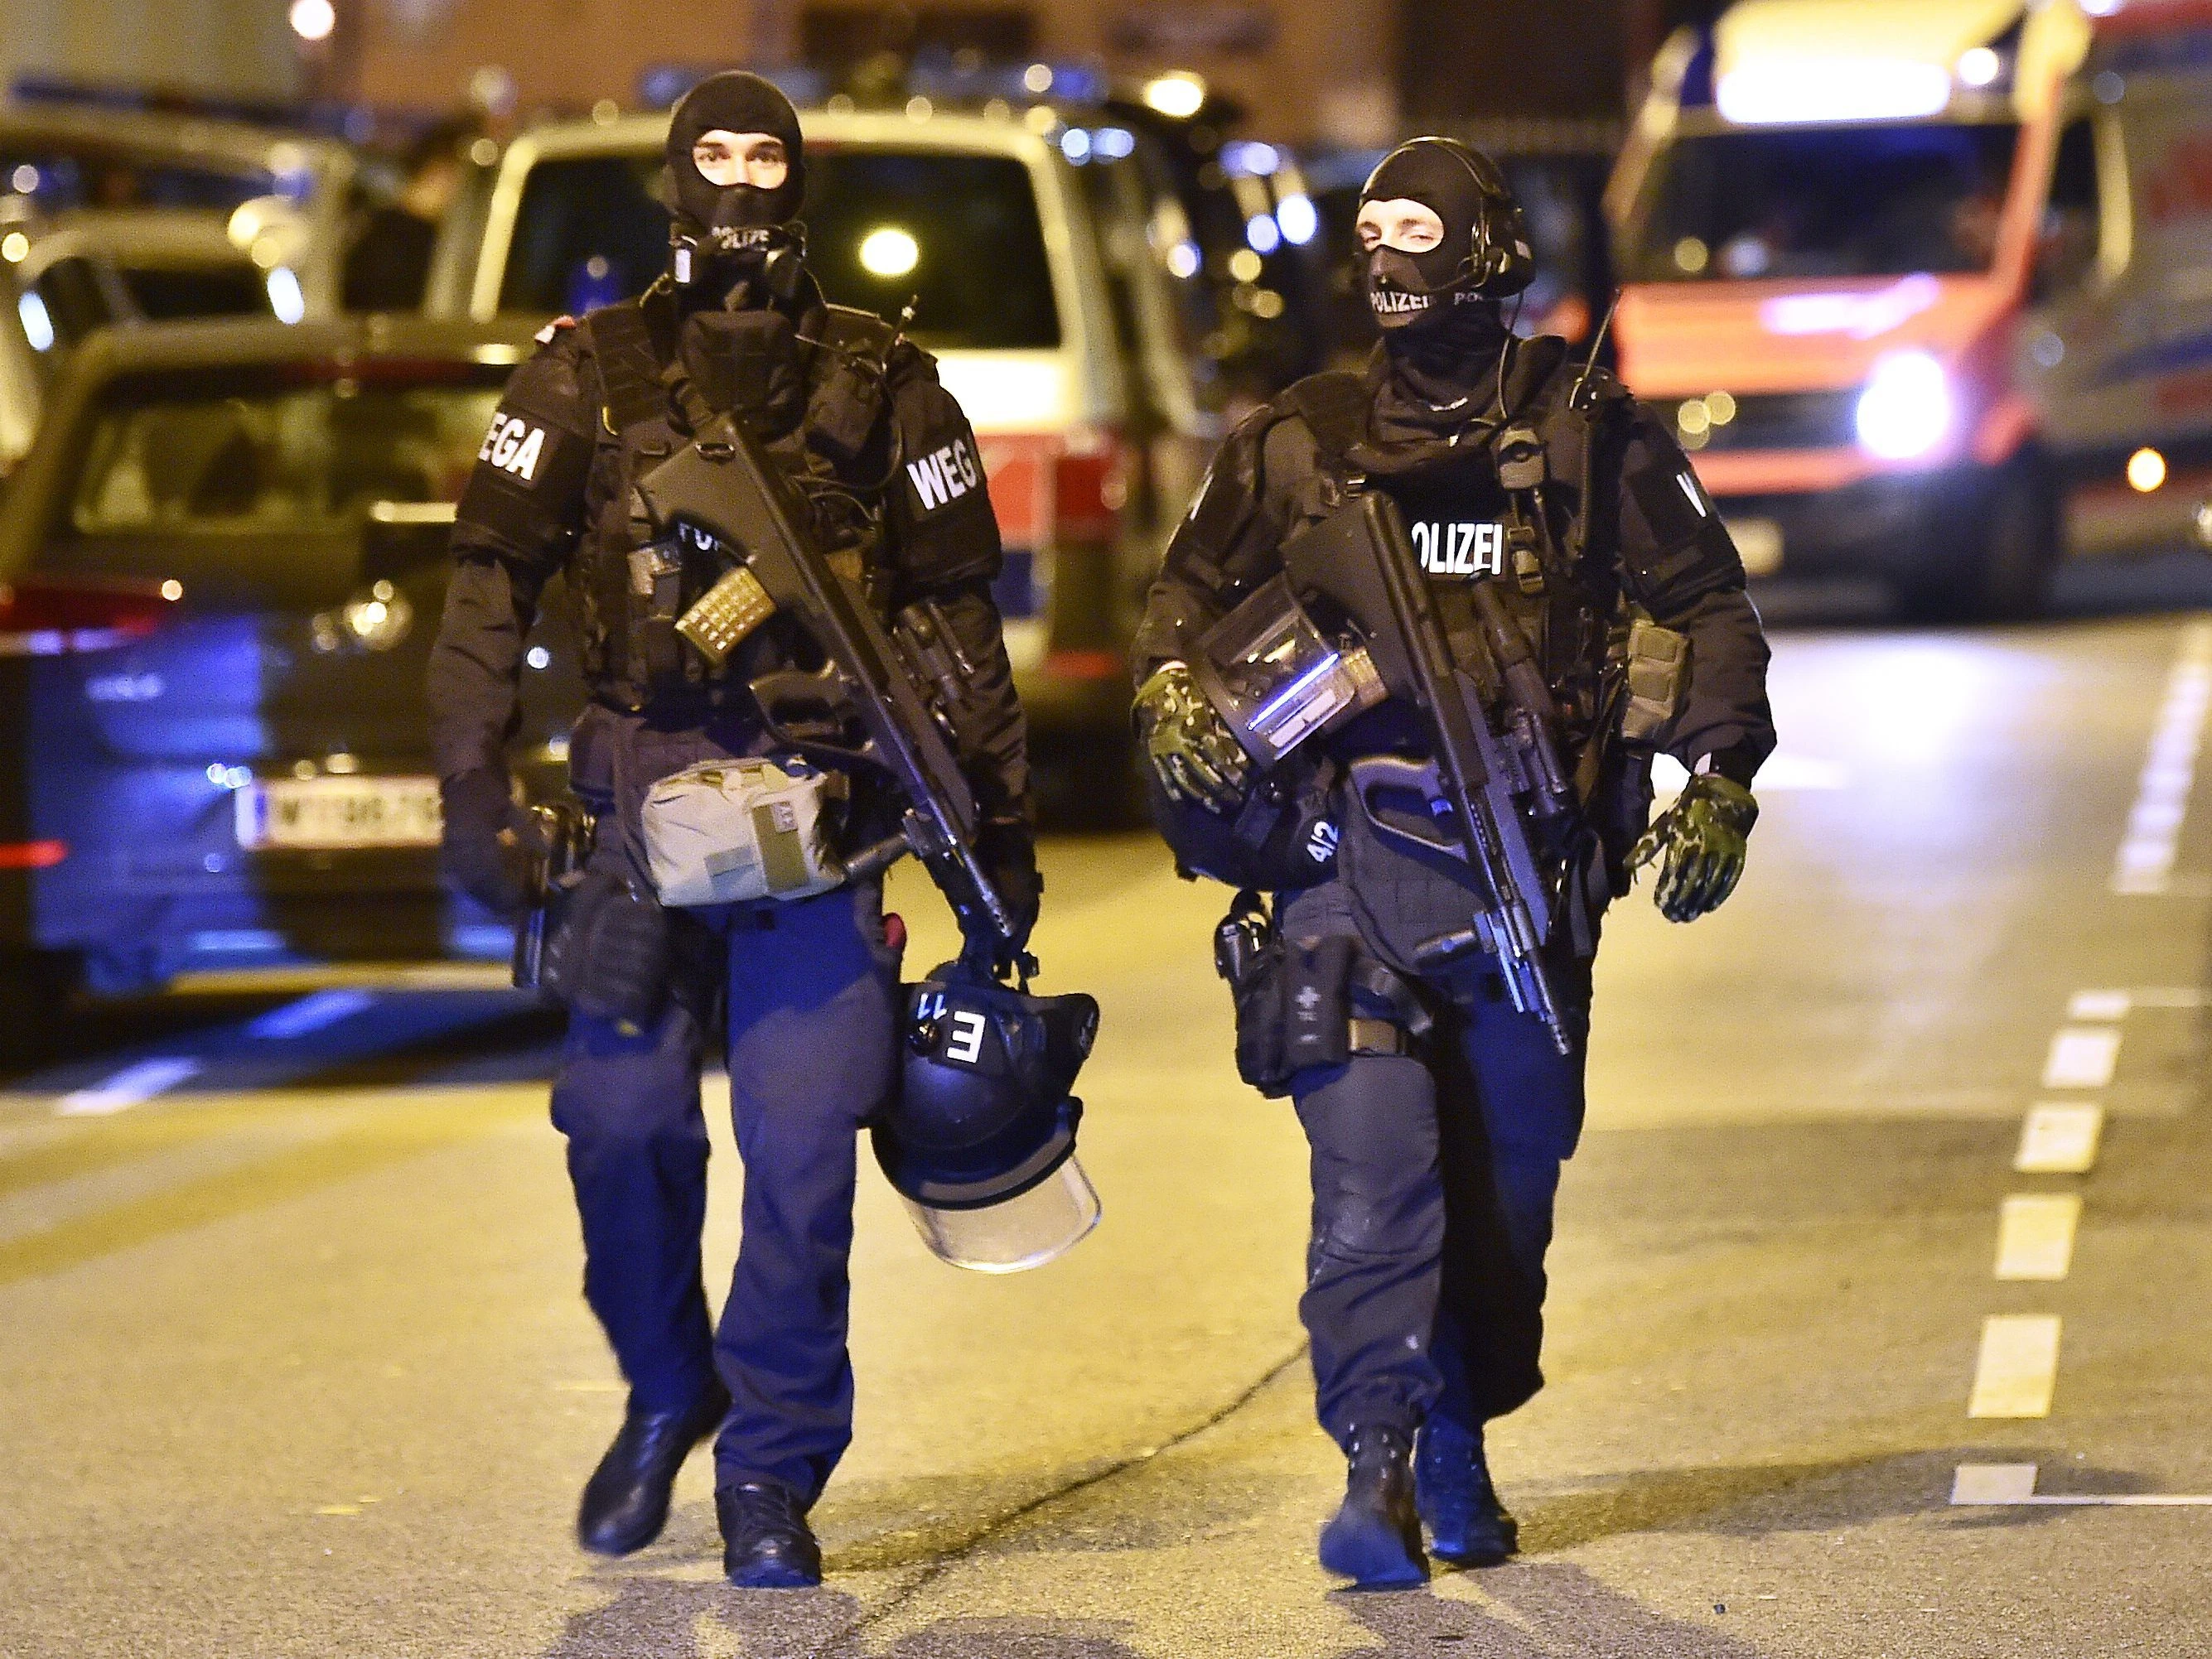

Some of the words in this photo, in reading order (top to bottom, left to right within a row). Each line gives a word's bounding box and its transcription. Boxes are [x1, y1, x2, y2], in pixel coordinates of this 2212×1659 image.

[478, 412, 545, 480] EGA
[906, 440, 977, 509] WEG
[1411, 521, 1504, 575] OLIZEI
